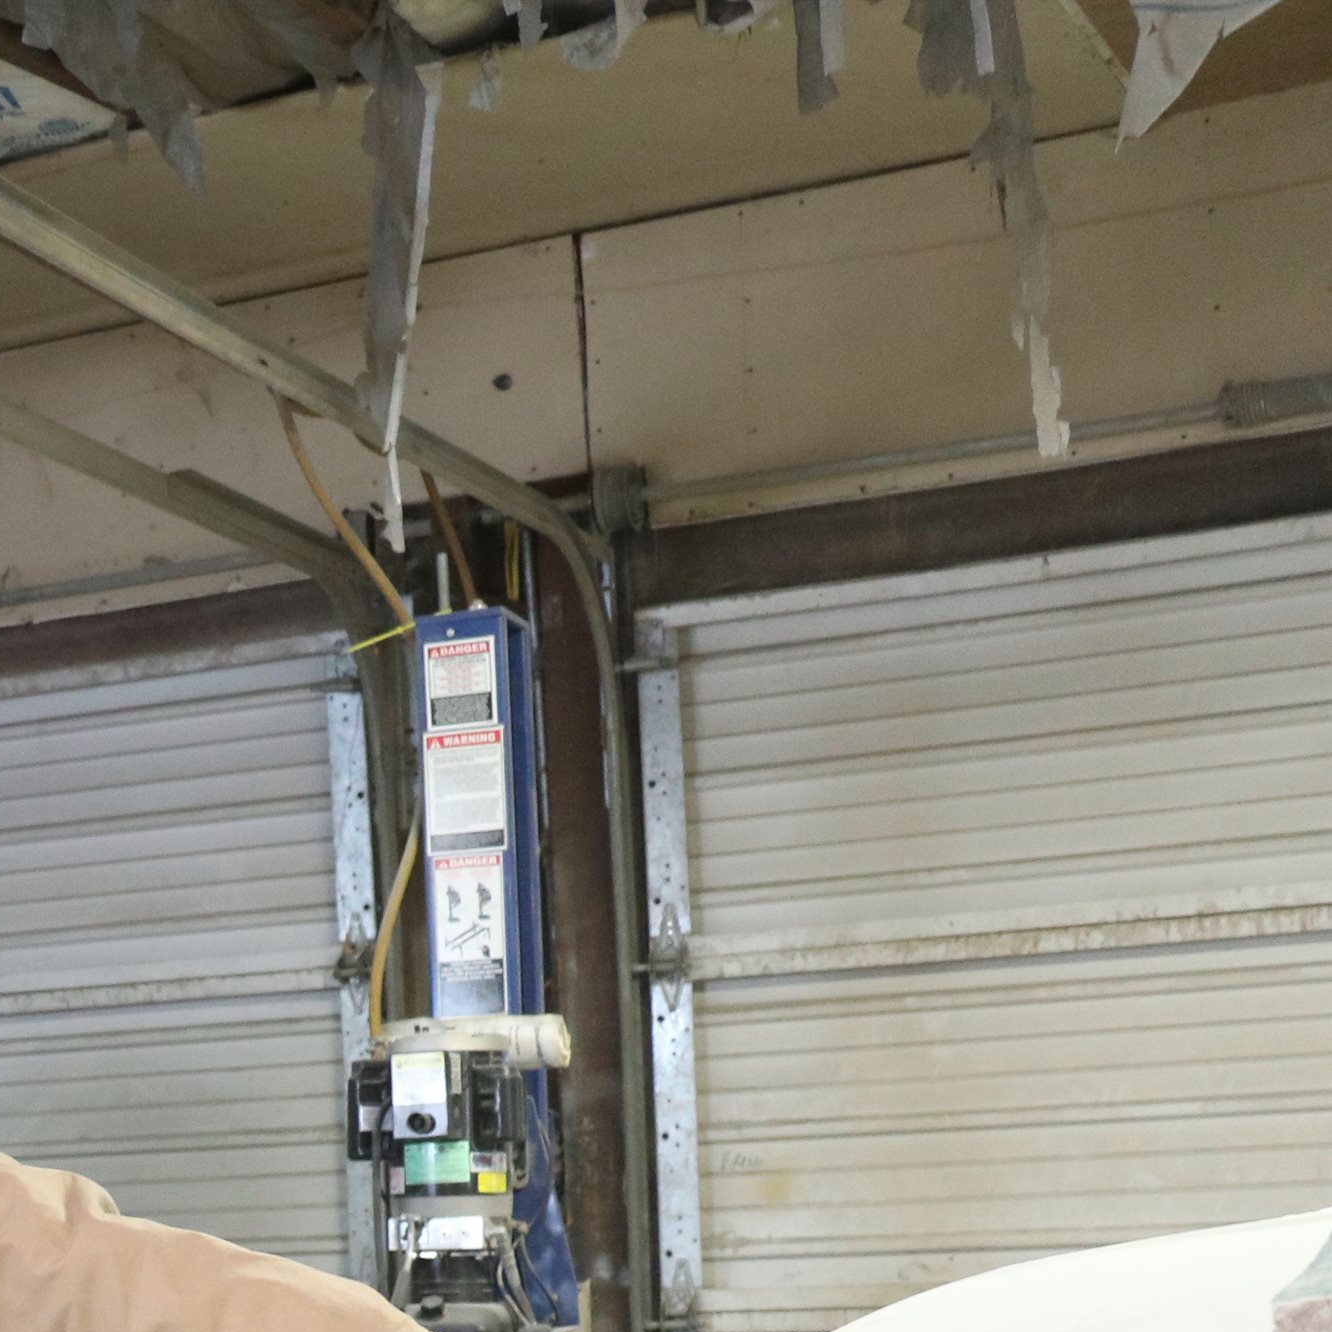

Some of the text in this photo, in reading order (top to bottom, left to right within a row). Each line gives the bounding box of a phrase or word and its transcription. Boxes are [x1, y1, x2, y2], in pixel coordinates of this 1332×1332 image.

[439, 641, 489, 656] DANGER
[442, 732, 496, 747] WARNING
[448, 855, 498, 868] DANGER
